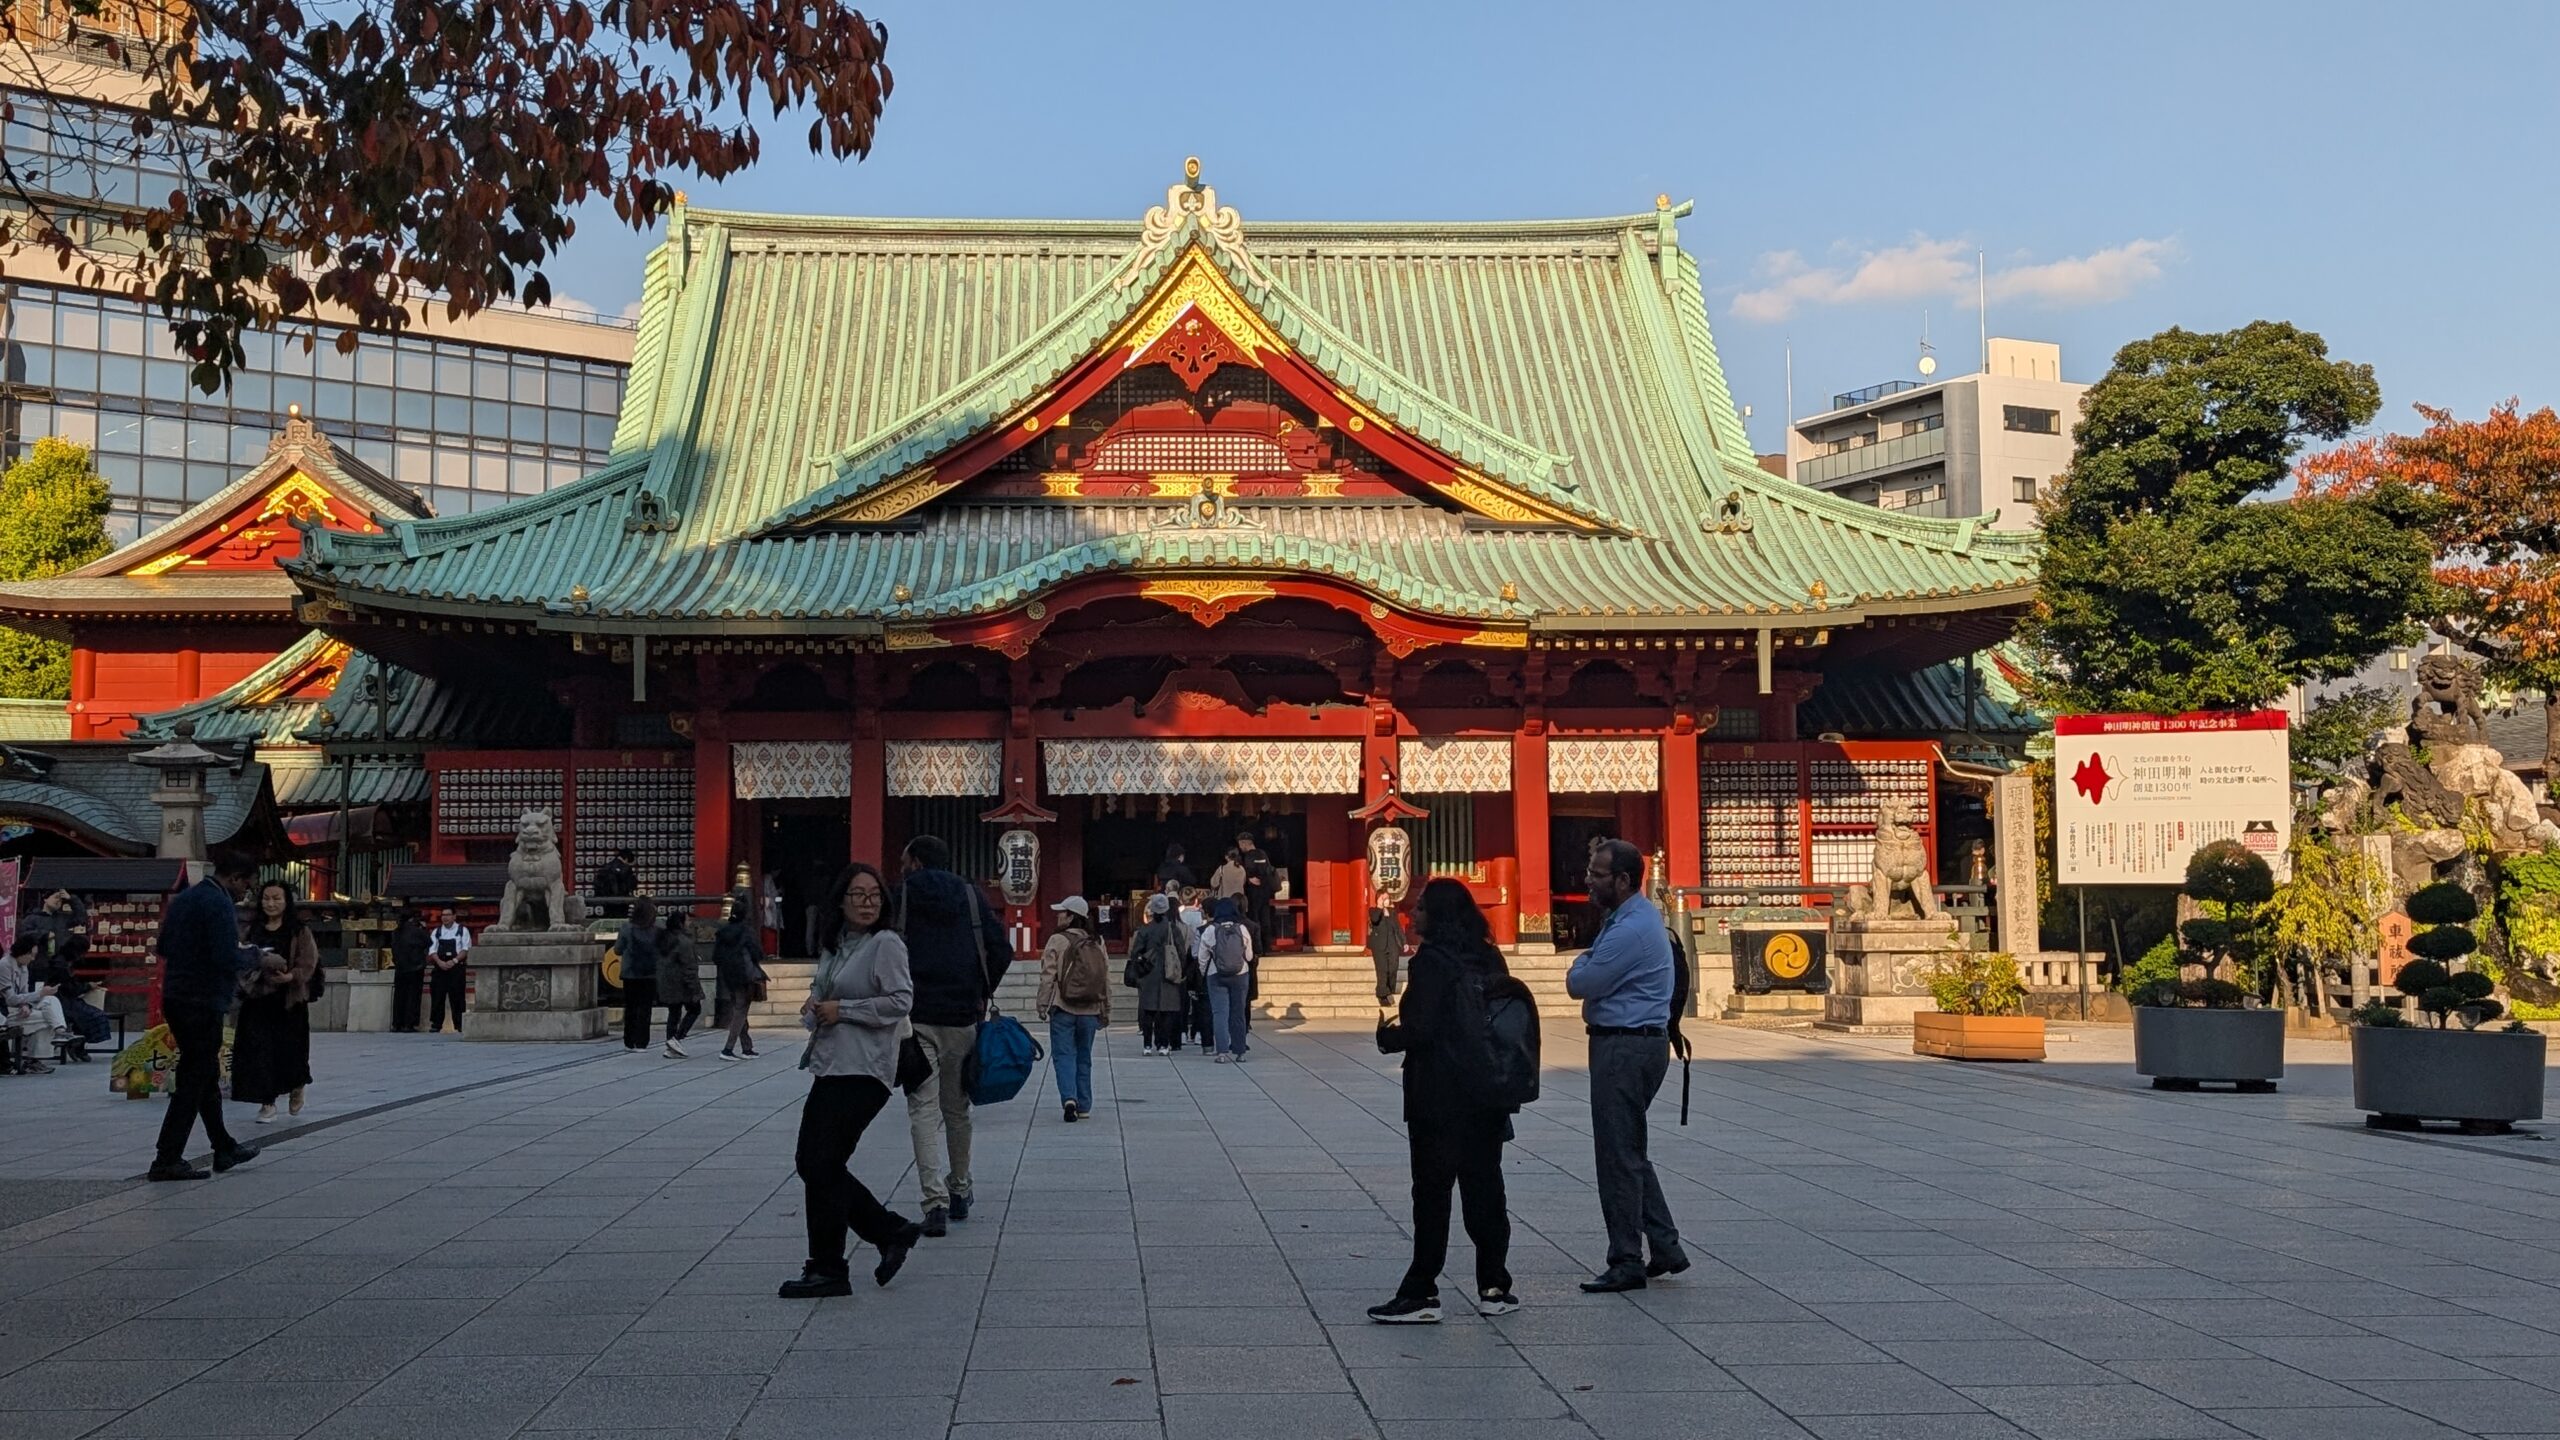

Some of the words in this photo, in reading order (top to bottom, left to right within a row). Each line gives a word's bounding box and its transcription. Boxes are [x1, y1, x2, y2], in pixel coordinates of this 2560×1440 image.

[2133, 765, 2191, 780] 神田明神
[2133, 782, 2192, 793] 創建1300年
[2243, 833, 2278, 844] EDOCCO
[1010, 843, 1033, 893] 神田明神
[1378, 842, 1402, 891] 神田明神
